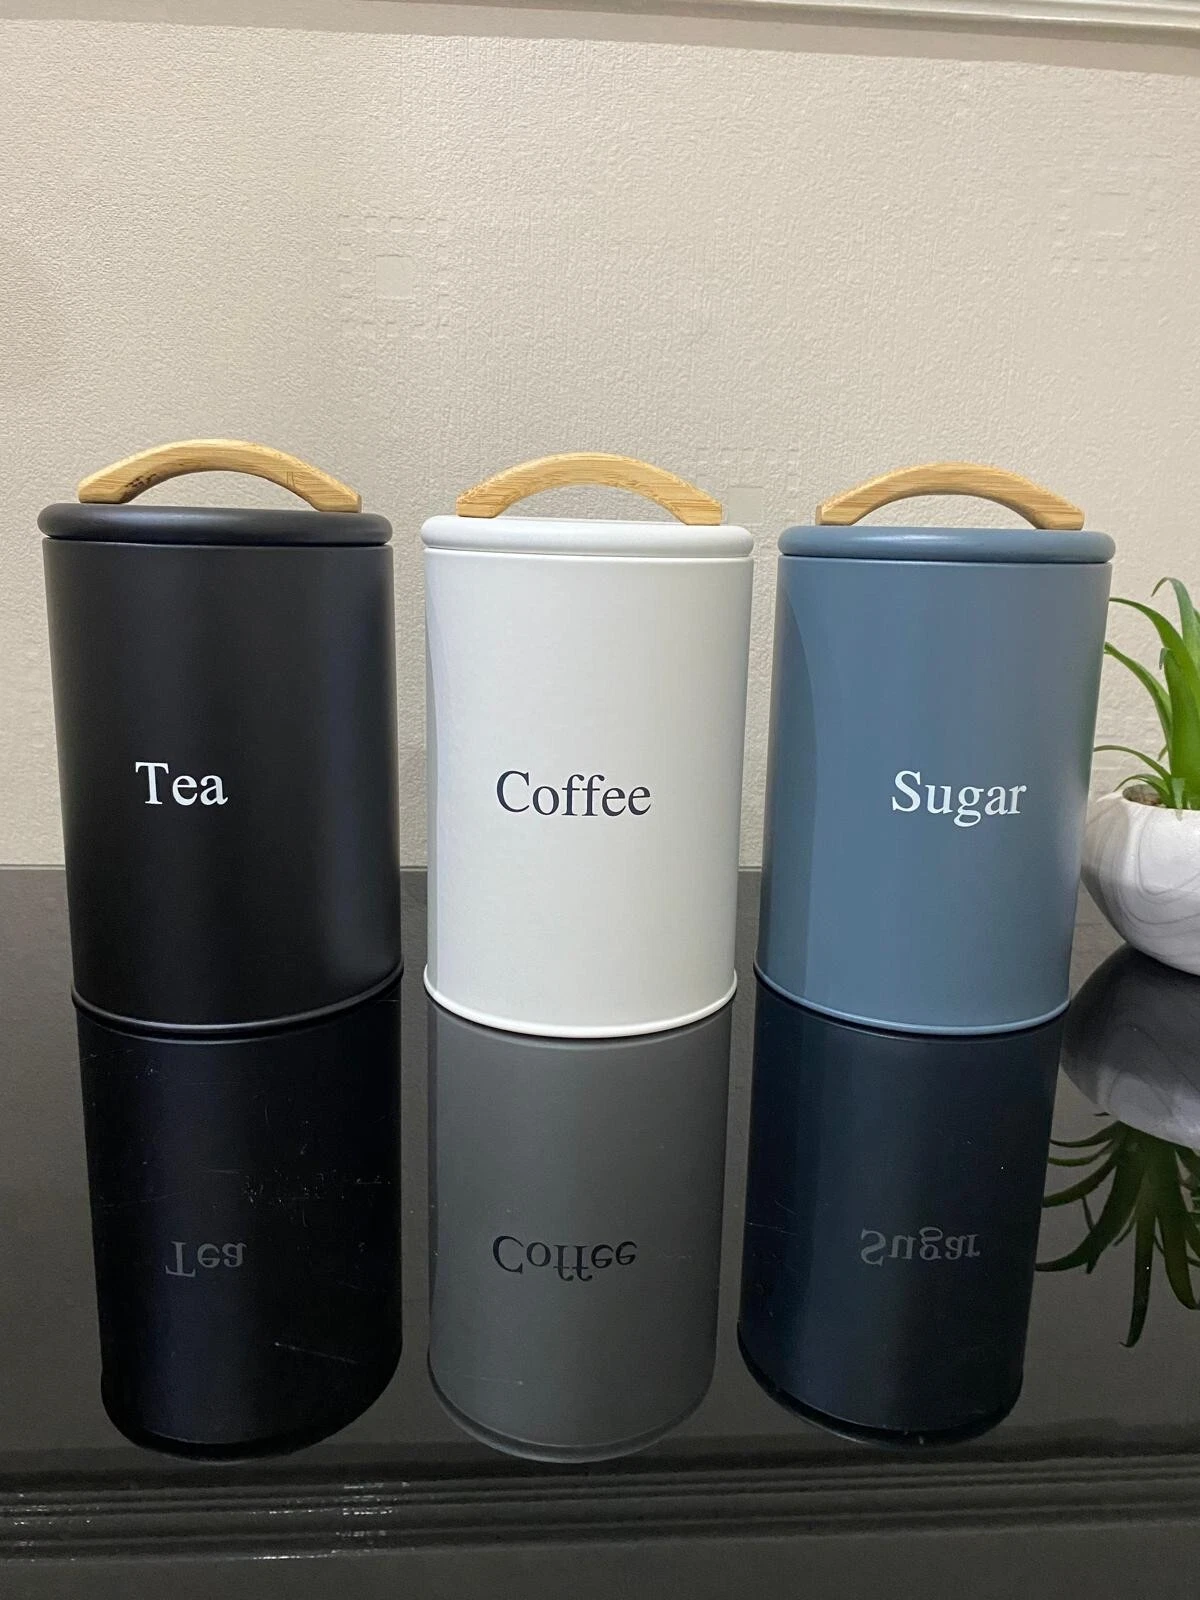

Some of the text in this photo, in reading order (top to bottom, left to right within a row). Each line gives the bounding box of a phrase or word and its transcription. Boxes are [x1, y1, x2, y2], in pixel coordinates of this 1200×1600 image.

[135, 761, 229, 806] Tea
[496, 770, 652, 817] Coffee
[891, 770, 1028, 828] Sugar
